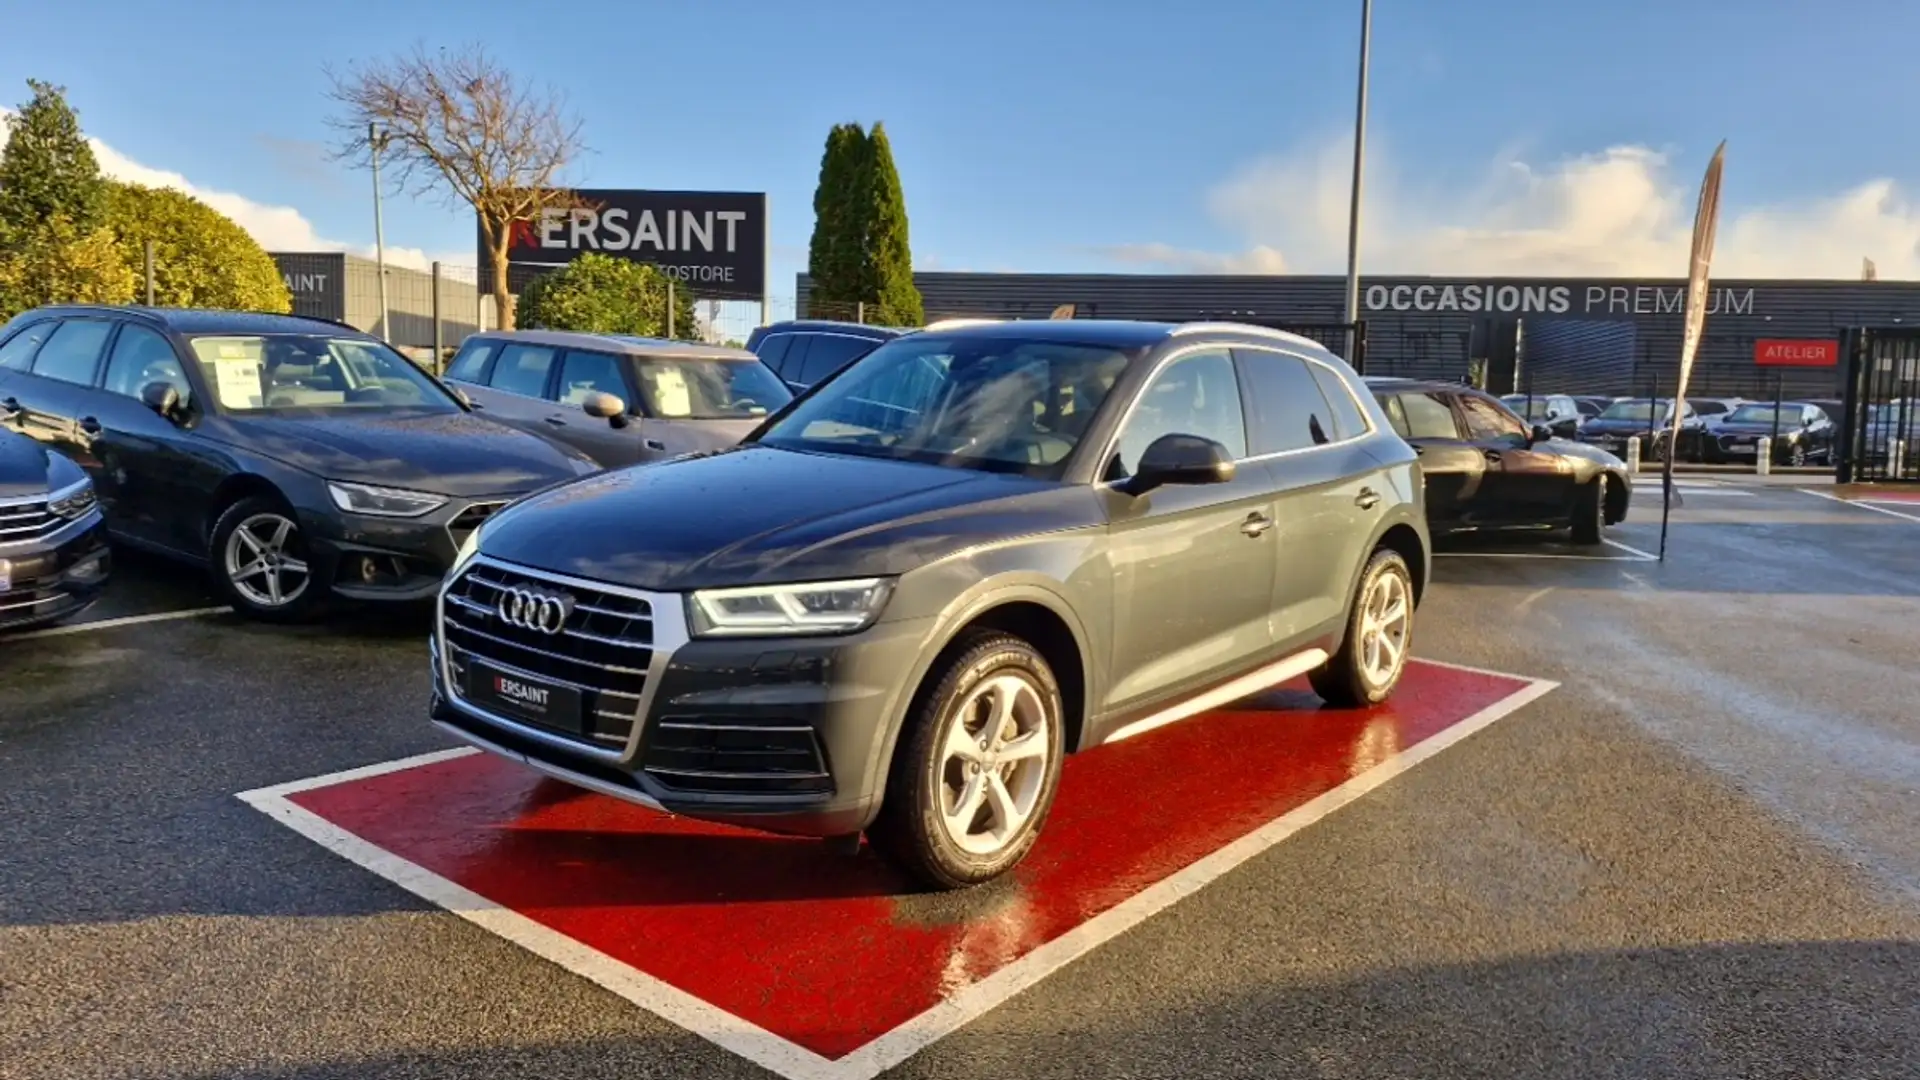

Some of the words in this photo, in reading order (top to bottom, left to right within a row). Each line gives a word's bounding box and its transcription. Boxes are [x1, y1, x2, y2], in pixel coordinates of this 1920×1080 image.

[658, 264, 735, 282] TOSTORE
[284, 273, 327, 292] AINT
[1365, 284, 1571, 313] OCCASIONS
[1585, 285, 1754, 315] PREMUM
[1764, 345, 1826, 360] ATELIER
